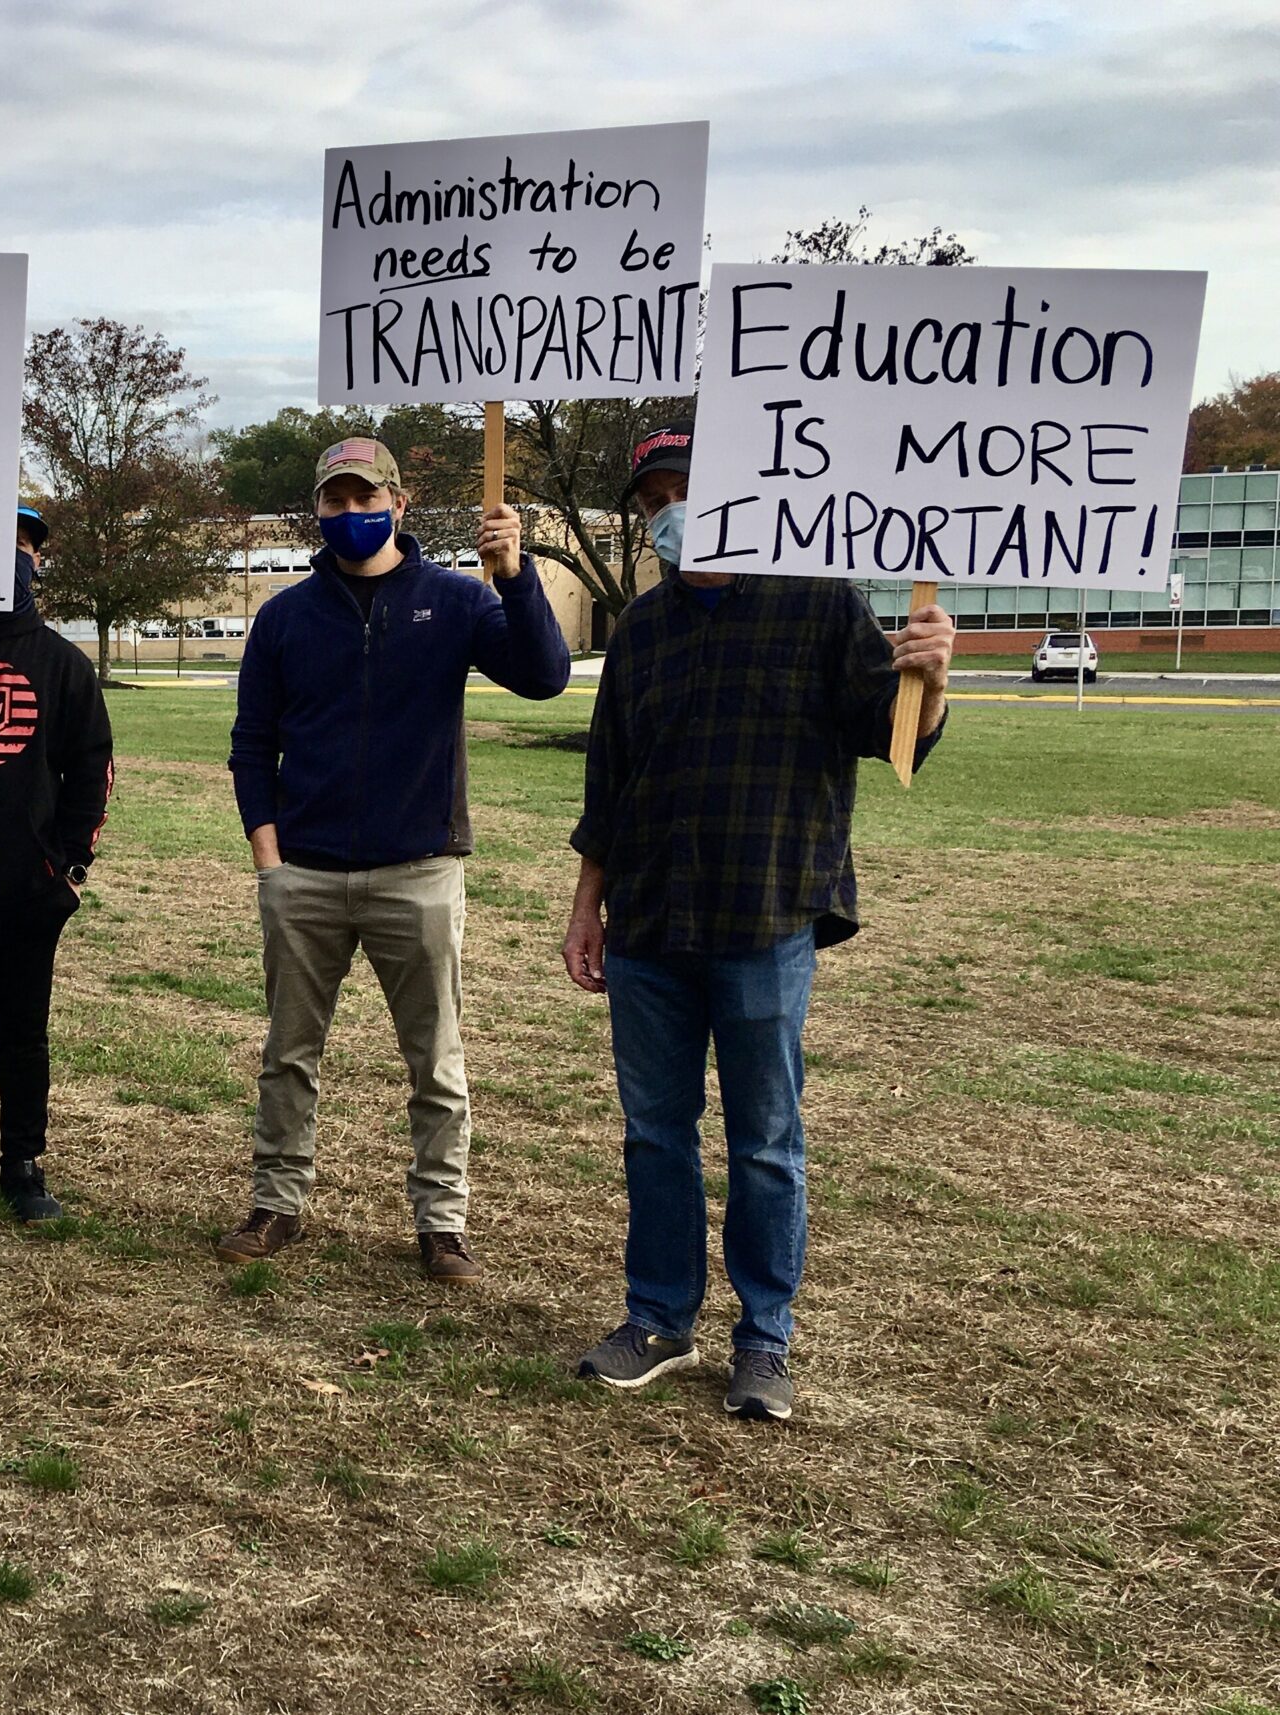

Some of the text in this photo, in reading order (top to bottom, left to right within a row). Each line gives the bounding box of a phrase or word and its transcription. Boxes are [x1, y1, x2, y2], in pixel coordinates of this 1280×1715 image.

[332, 156, 660, 229] Administration
[373, 229, 675, 283] needs to be
[326, 282, 699, 390] TRANSPARENT
[732, 282, 1153, 387] Education
[896, 421, 1148, 486] MORE
[693, 491, 1157, 578] IMPORTANT!
